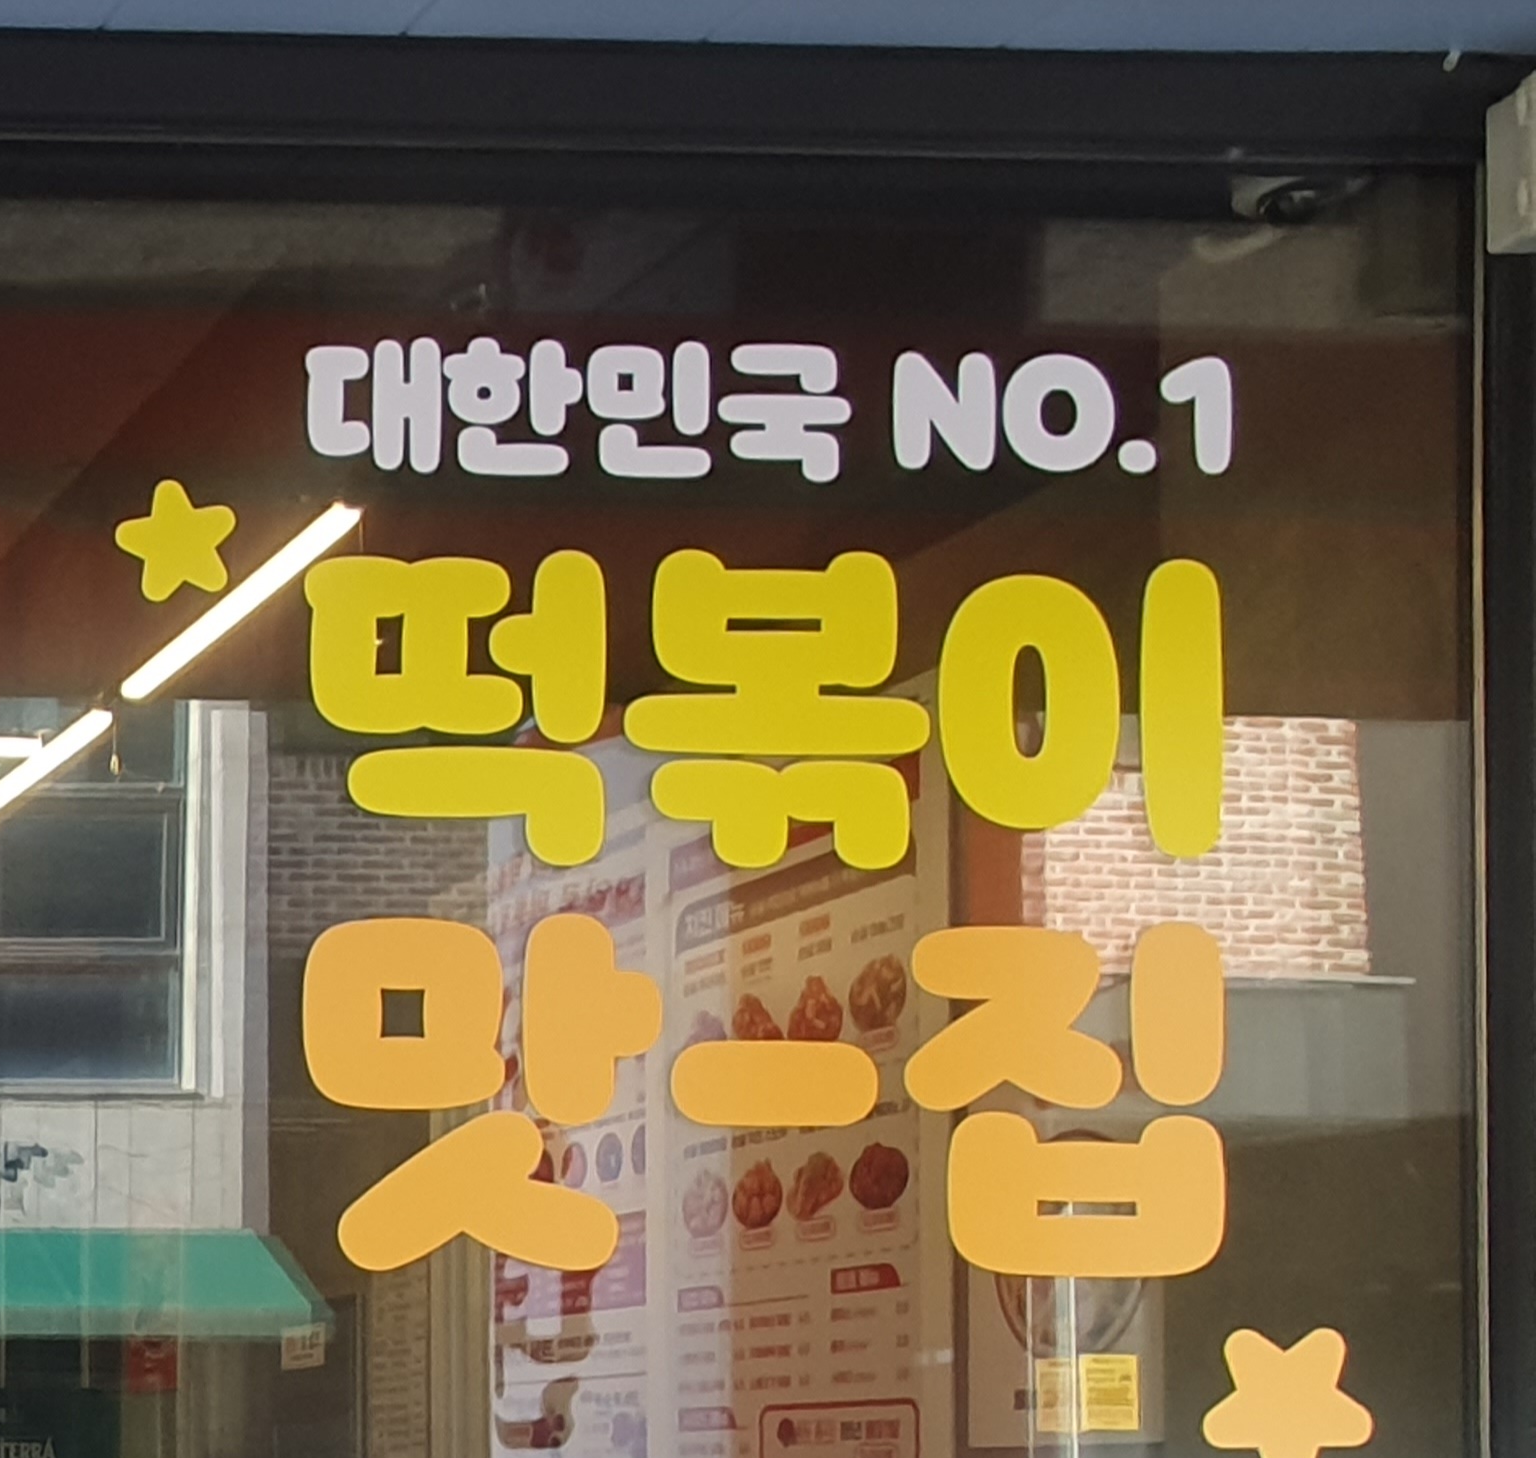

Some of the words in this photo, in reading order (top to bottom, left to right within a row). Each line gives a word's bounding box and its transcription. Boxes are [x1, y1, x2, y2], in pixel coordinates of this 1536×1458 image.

[305, 337, 852, 482] 대한민국
[893, 352, 1233, 474] NO.1
[304, 547, 1226, 869] 떡볶이
